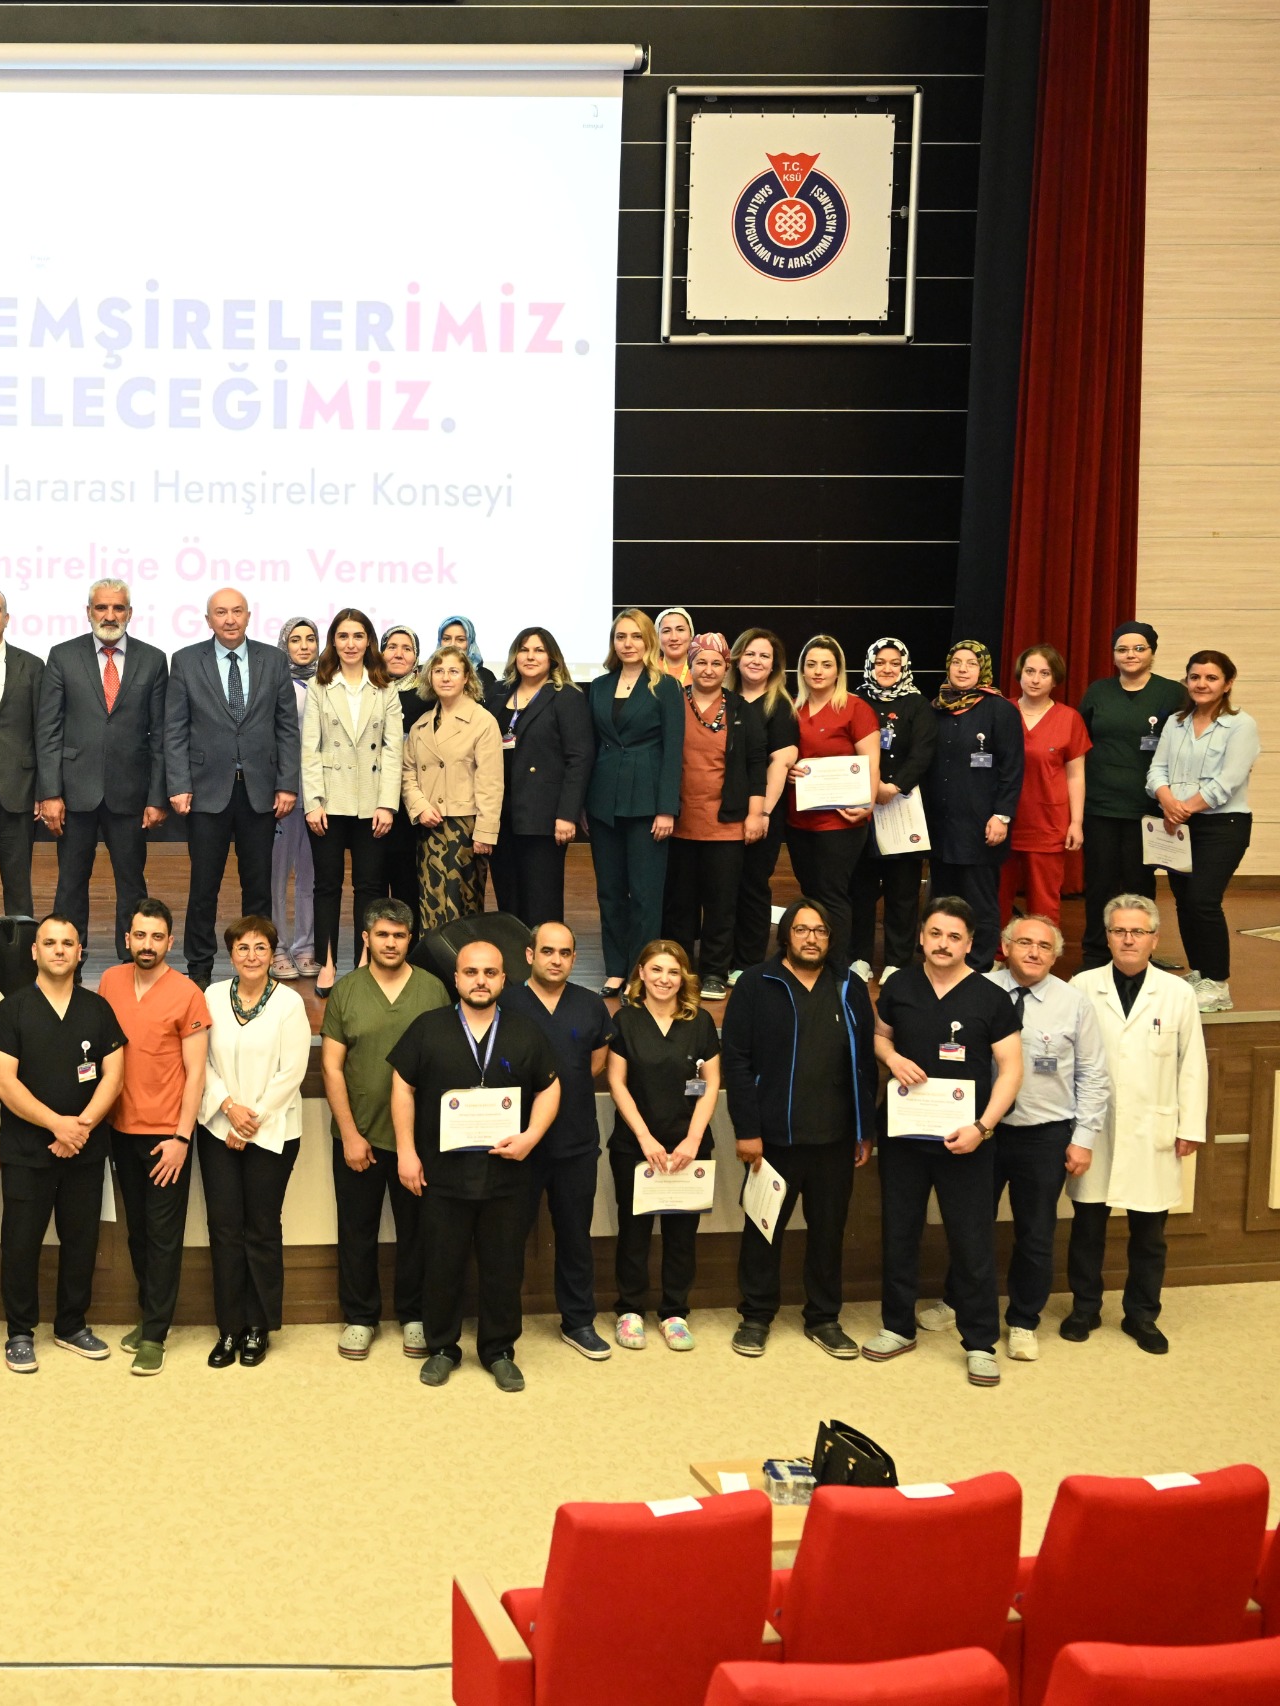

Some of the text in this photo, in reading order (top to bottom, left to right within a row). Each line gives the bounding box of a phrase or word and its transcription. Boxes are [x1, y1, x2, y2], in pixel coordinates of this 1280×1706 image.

[782, 161, 803, 171] T.C.
[782, 173, 802, 182] KSÜ
[744, 184, 837, 269] SAĞLIK UYGULAMA VE ARAŞTIRMA HASTANESİ
[153, 468, 356, 515] Hemşireler
[372, 471, 513, 518] Konseyi
[175, 536, 290, 582] Önem
[306, 547, 458, 584] Vermek
